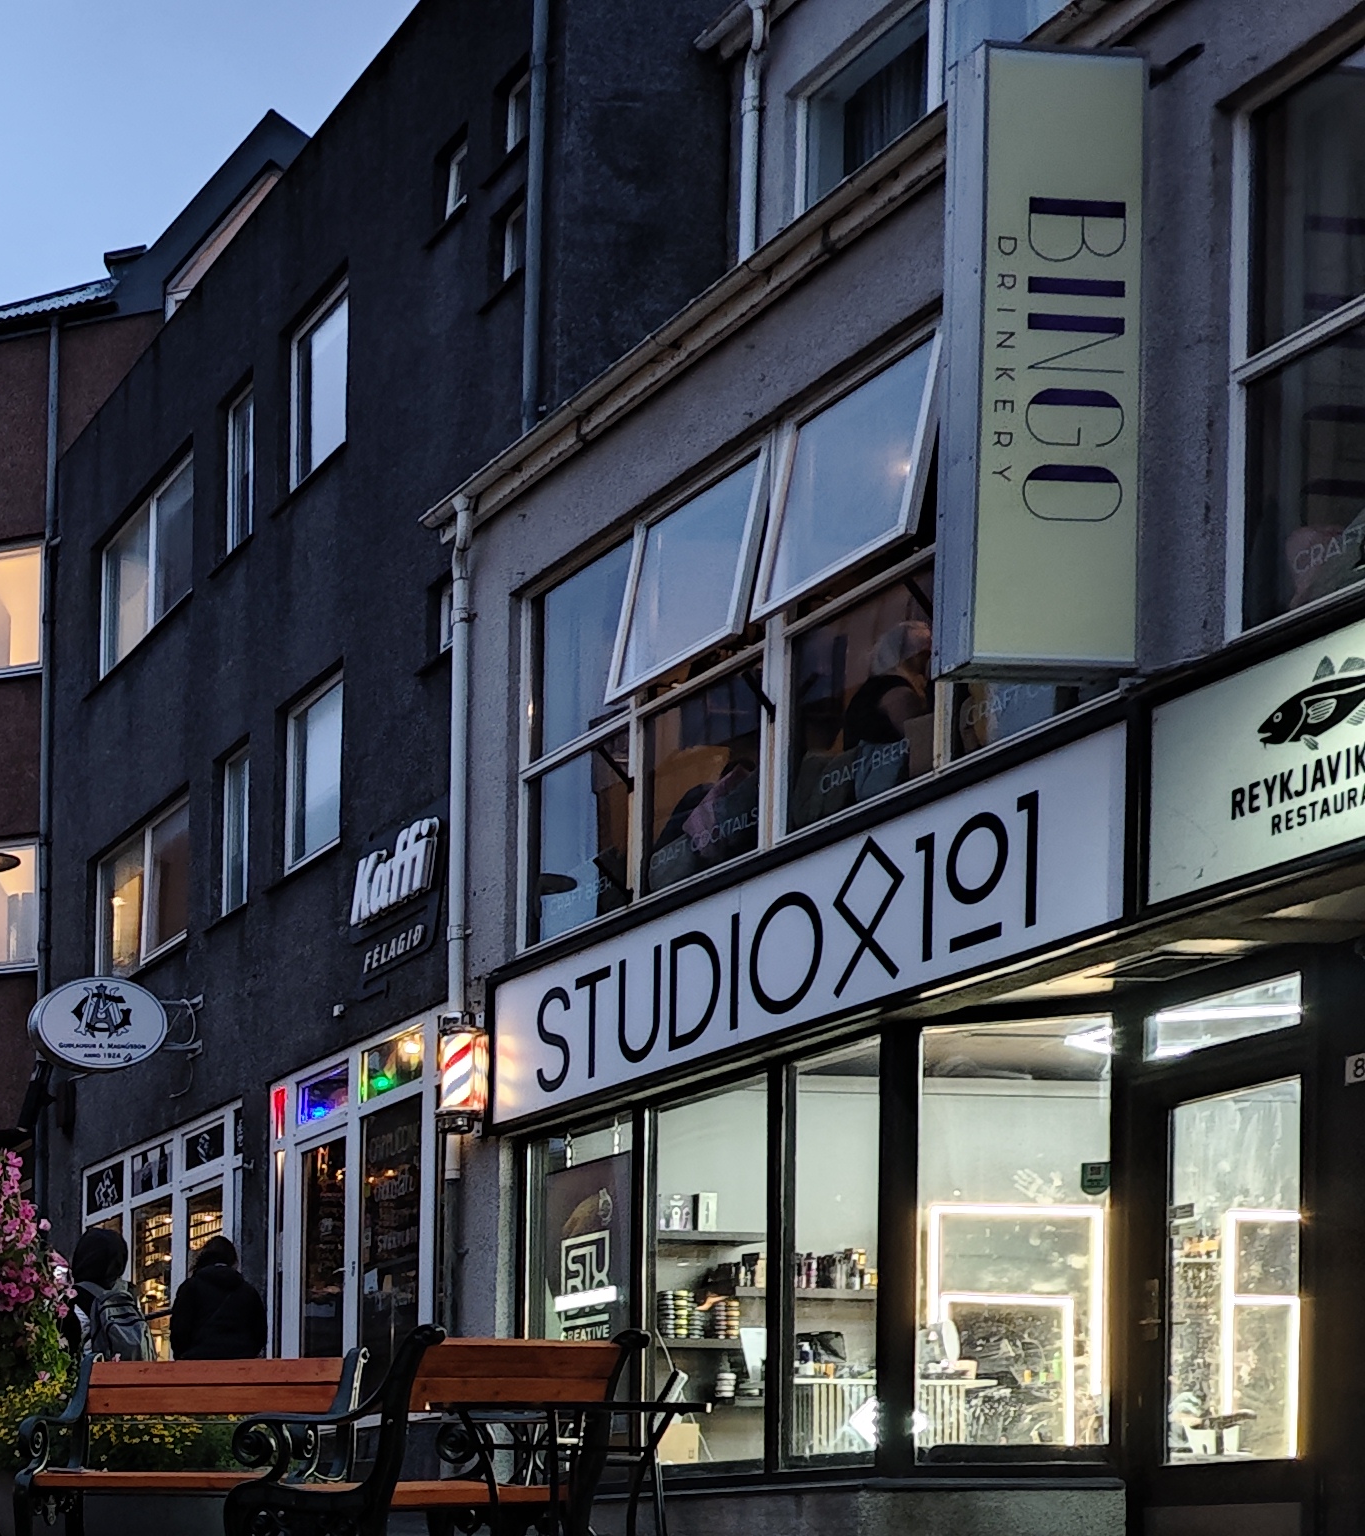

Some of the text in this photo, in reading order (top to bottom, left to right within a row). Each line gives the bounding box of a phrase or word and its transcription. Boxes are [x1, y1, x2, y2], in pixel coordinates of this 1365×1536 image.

[991, 234, 1018, 482] DRINKERY
[1022, 196, 1127, 522] BINGO
[820, 738, 910, 794] CRAFT BEER
[1231, 741, 1365, 820] REYKJAVIK
[691, 807, 758, 852] COCKTAILS
[350, 816, 440, 928] Kaffi
[363, 924, 426, 974] FÉLAGIÐ
[536, 890, 823, 1093] STUDIO
[560, 1323, 610, 1342] CREATIVE
